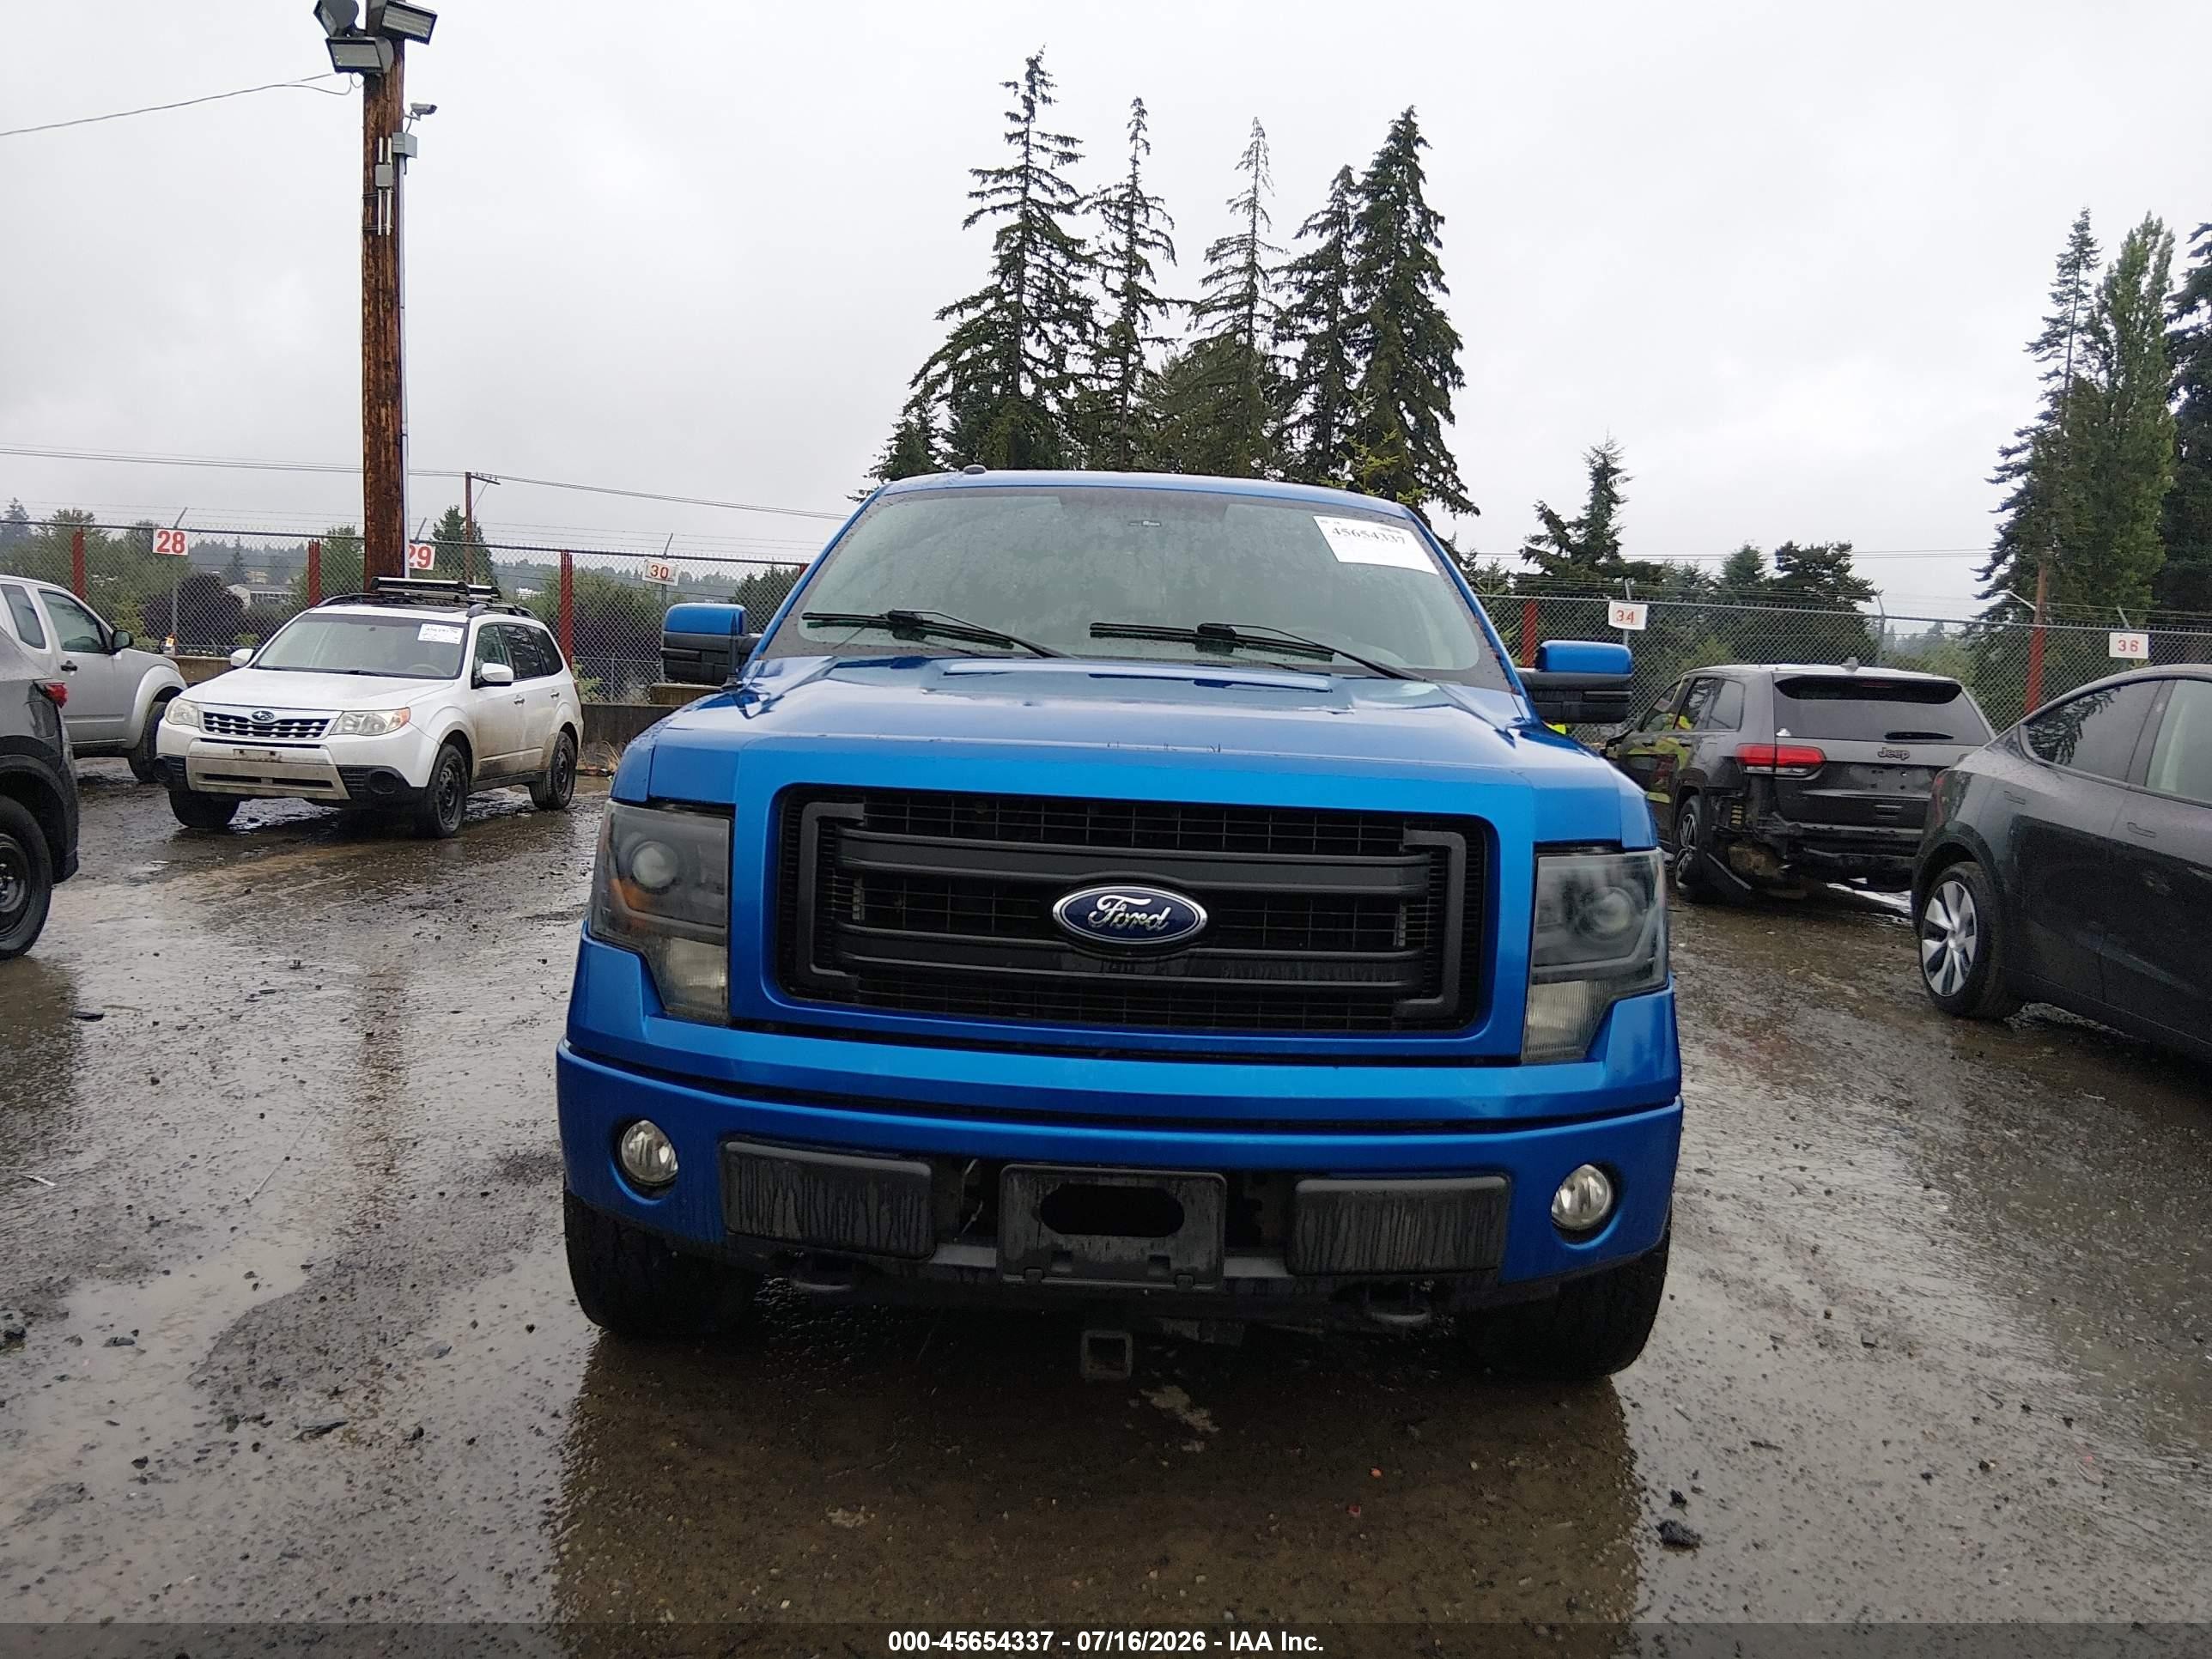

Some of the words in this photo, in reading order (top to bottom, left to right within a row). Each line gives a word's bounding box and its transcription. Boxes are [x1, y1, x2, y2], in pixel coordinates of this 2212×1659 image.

[157, 530, 185, 554] 28
[1332, 526, 1406, 544] 45654337
[650, 564, 669, 579] 30
[1615, 610, 1635, 623] 34
[2118, 639, 2139, 652] 36
[1877, 746, 1911, 761] Jeep
[1087, 894, 1172, 932] Ford
